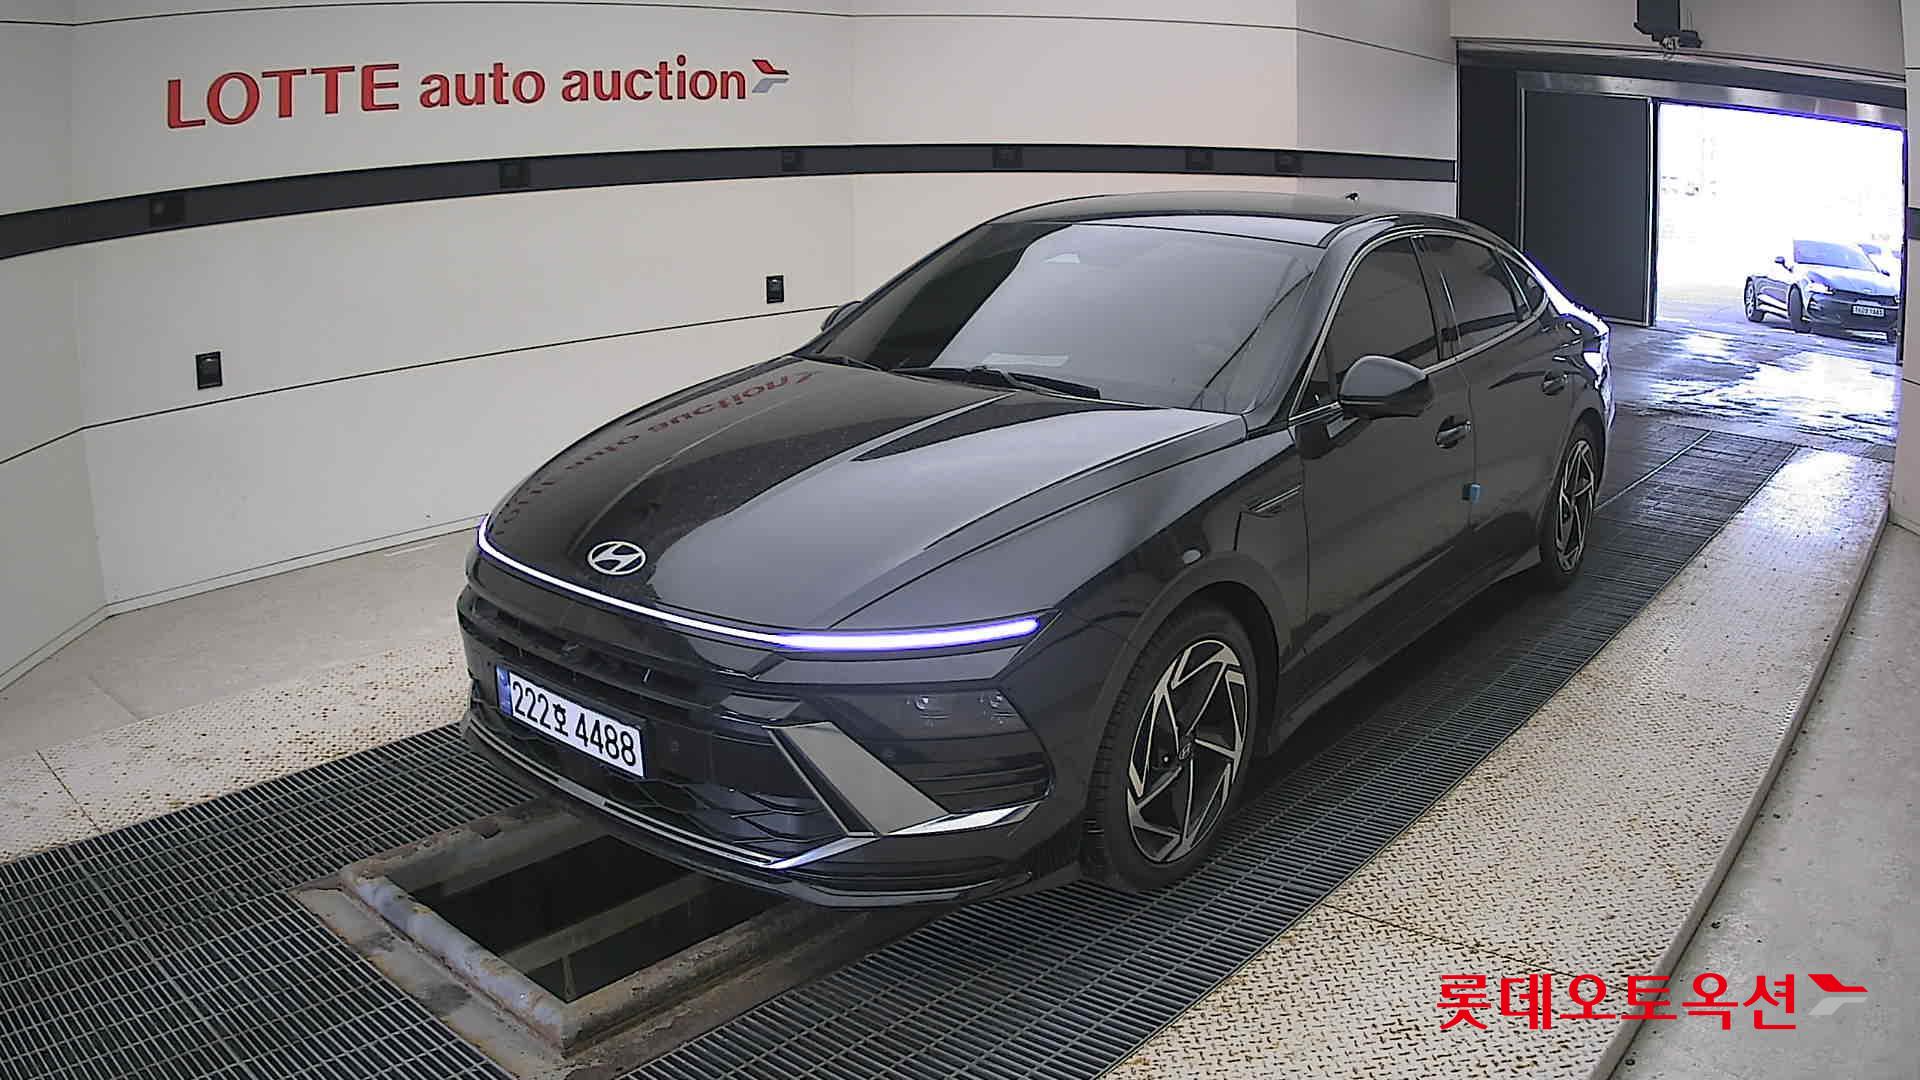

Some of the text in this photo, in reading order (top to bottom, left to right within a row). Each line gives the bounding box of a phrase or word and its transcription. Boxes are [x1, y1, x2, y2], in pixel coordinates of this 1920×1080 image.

[167, 54, 747, 129] LOTTE auto auction
[512, 681, 636, 767] 222호 4488
